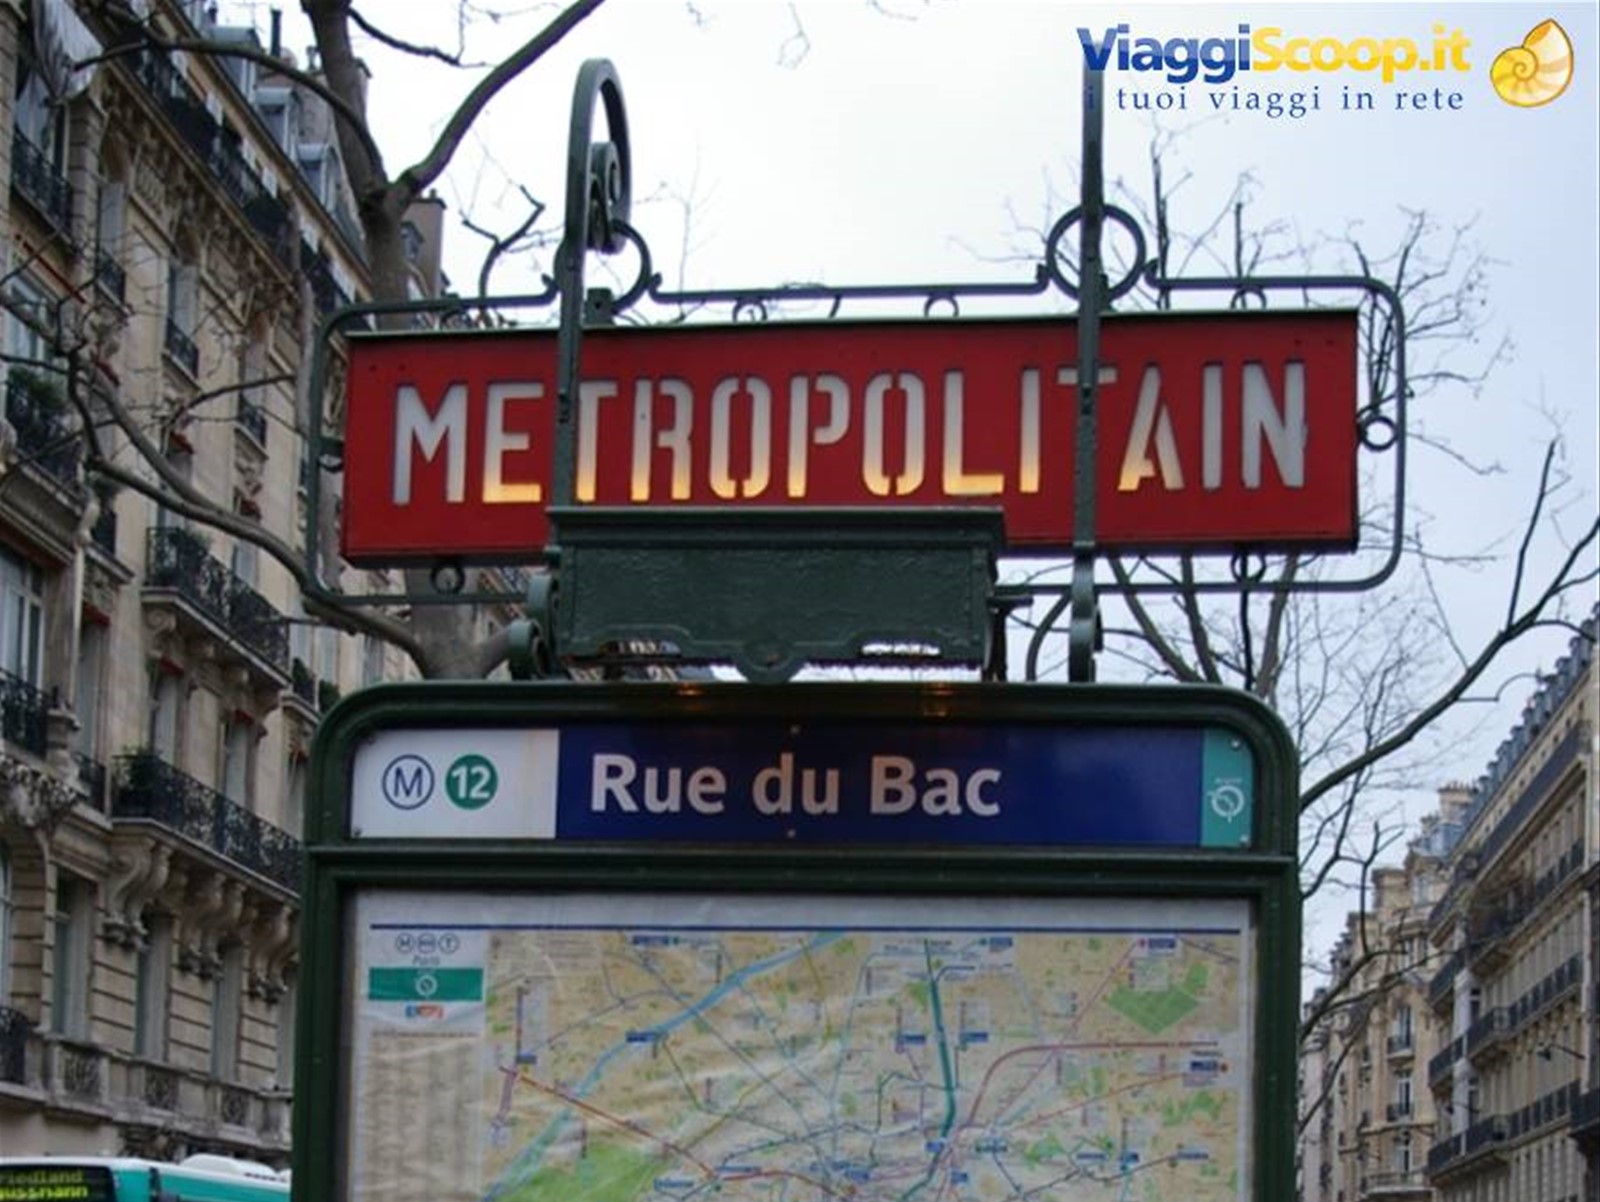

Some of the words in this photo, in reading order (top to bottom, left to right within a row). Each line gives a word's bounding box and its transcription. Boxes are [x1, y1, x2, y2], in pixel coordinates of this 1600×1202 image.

[393, 362, 1307, 505] METROPOLIAIN
[452, 765, 491, 799] 12
[591, 752, 727, 814] Rue
[752, 752, 840, 815] du
[869, 755, 1002, 817] Bac
